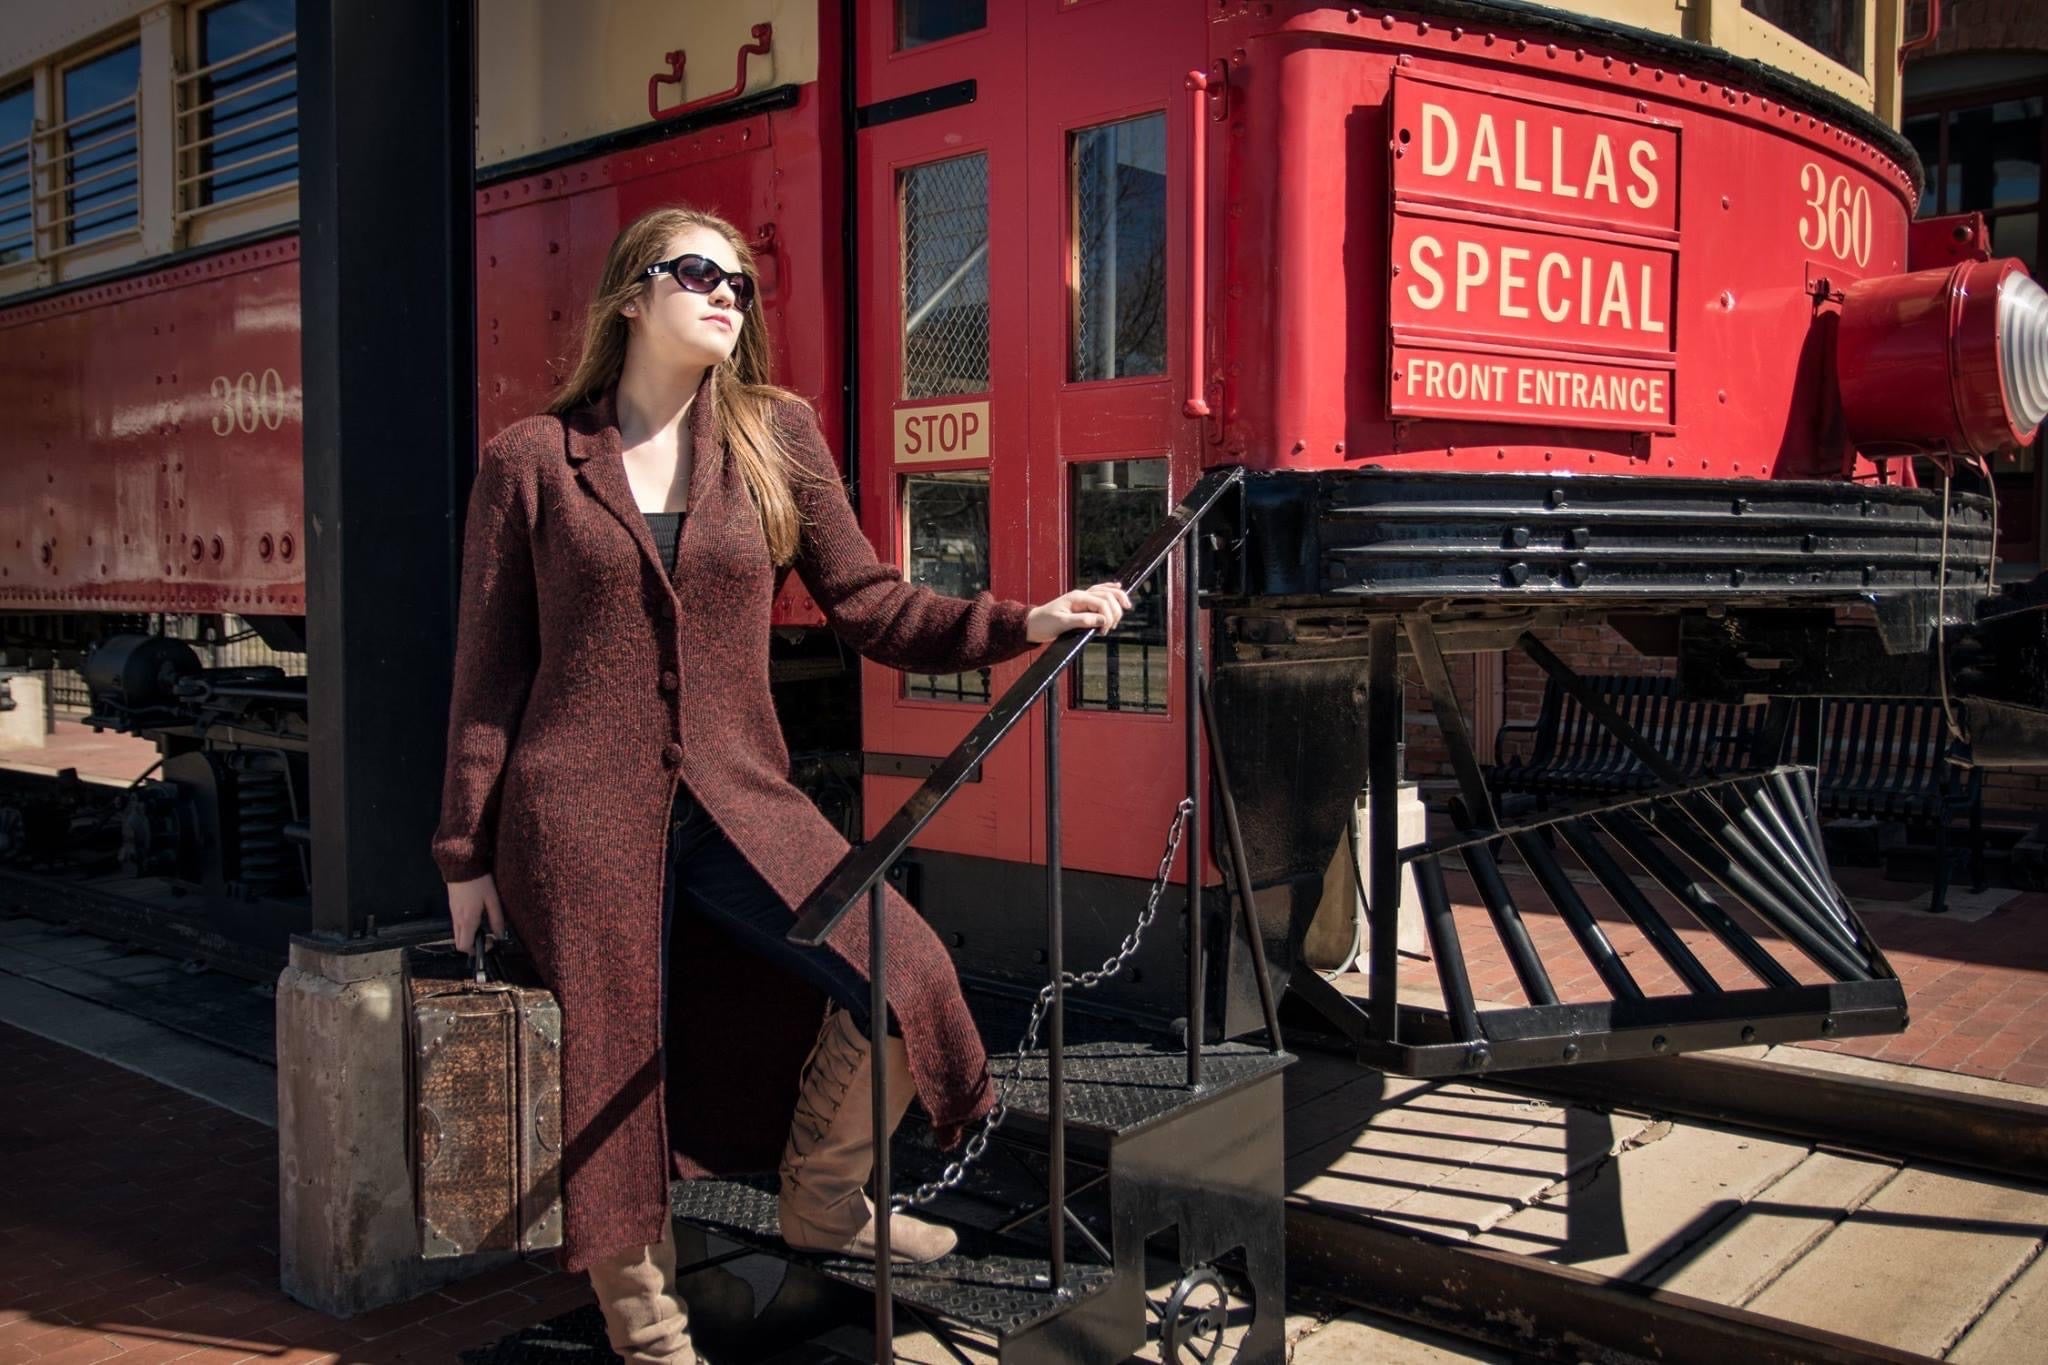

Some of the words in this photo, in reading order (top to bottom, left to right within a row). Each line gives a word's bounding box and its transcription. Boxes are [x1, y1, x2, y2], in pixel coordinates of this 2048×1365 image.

[1421, 102, 1659, 209] DALLAS
[1799, 162, 1872, 268] 360
[1407, 235, 1665, 333] SPECIAL
[210, 367, 284, 436] 360
[1407, 358, 1508, 402] FRONT
[1517, 368, 1665, 414] ENTRANCE
[904, 412, 979, 454] STOP
